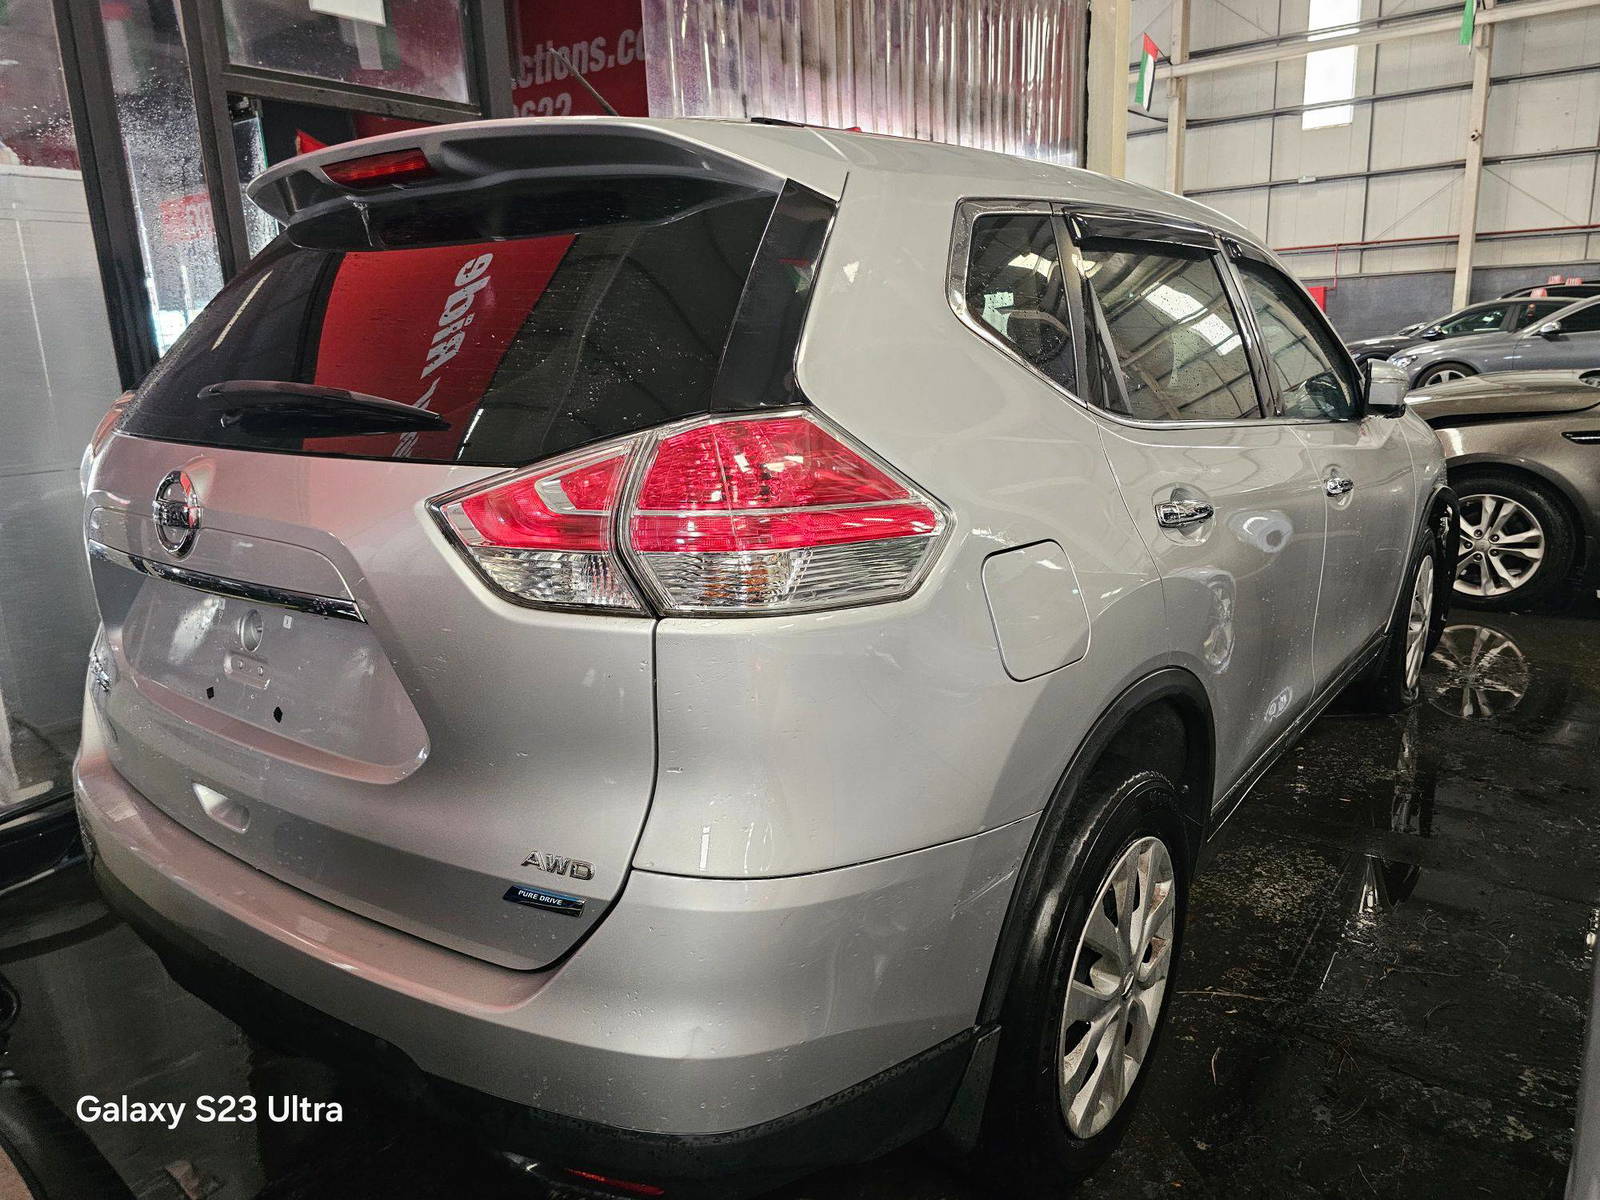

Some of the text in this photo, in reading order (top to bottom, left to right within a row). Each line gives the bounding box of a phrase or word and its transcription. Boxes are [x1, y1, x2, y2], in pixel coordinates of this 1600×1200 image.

[520, 850, 596, 881] AWD
[517, 889, 563, 906] PURE DRIVE
